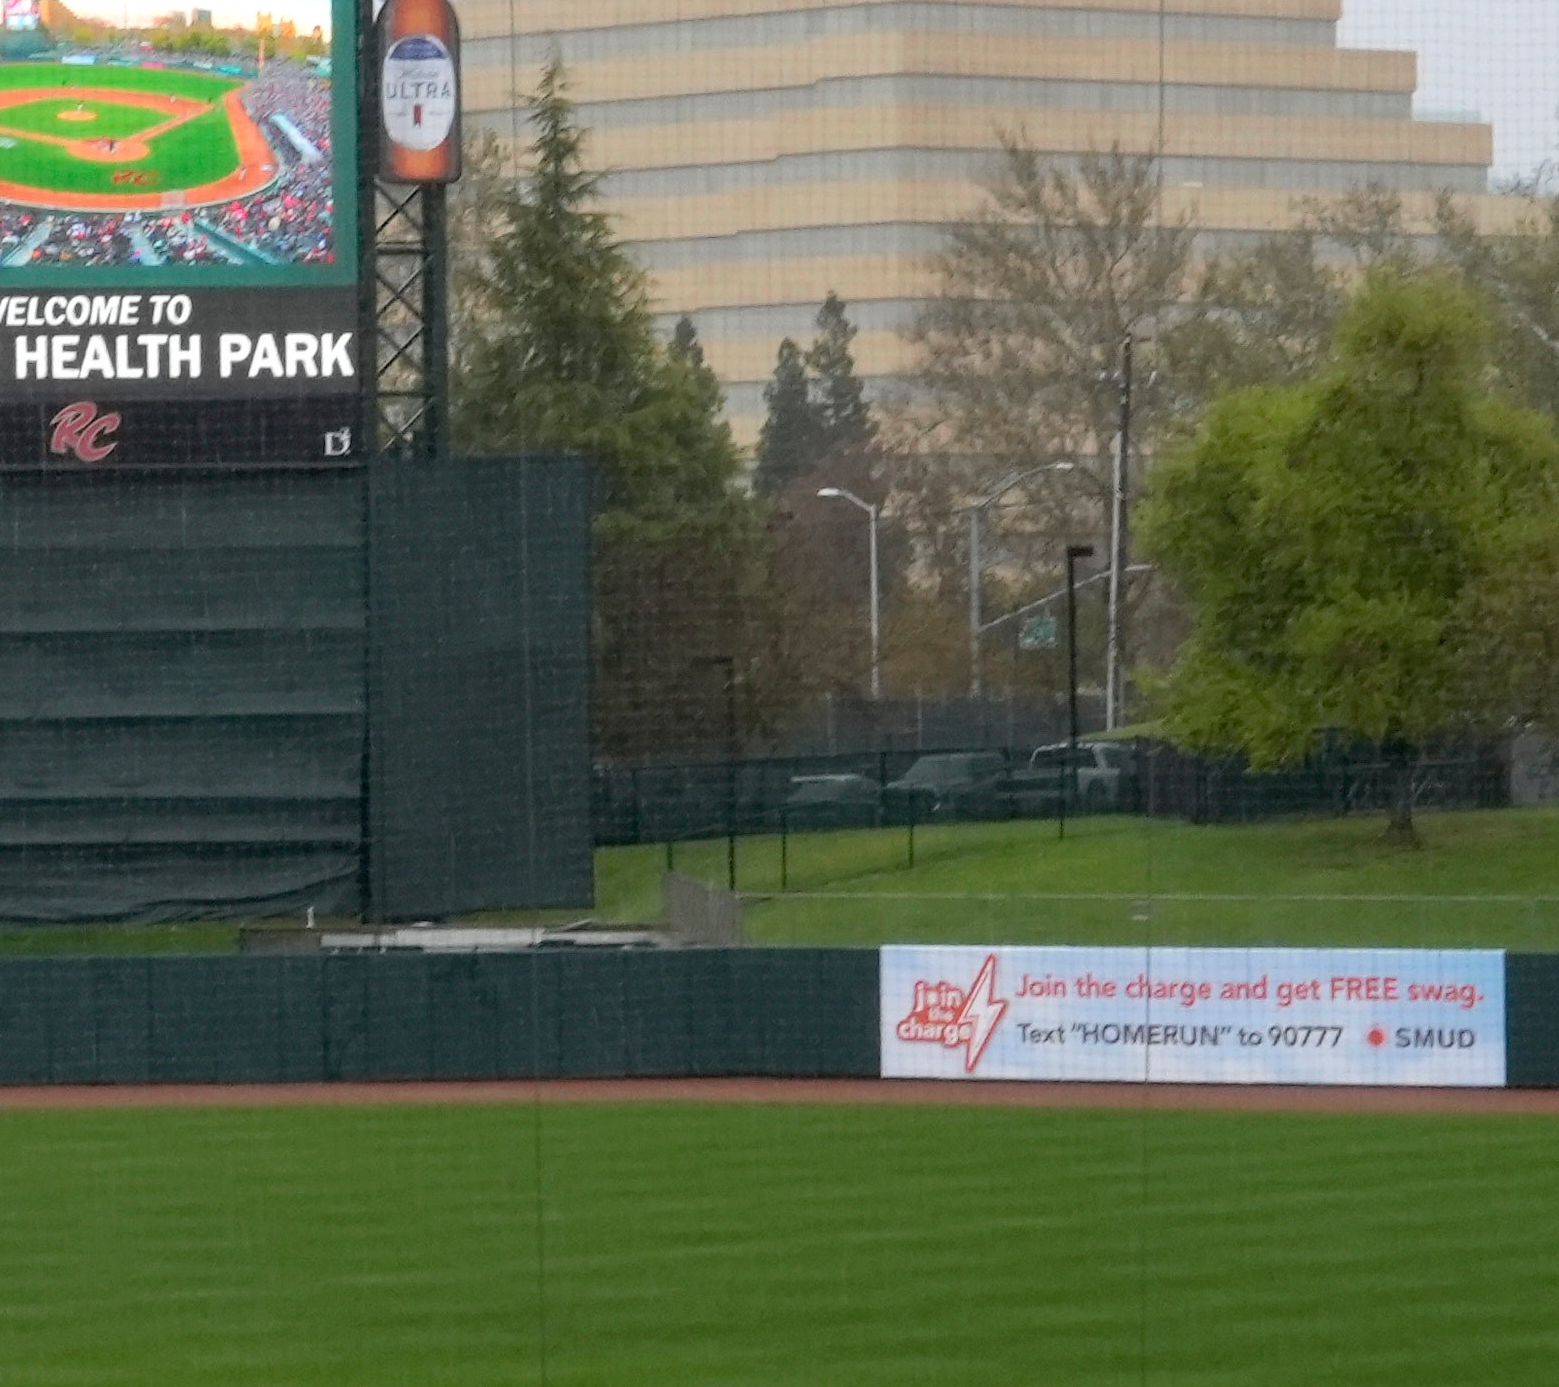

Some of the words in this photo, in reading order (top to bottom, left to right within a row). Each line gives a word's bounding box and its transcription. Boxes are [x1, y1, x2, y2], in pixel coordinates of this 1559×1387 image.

[150, 294, 192, 324] TO
[16, 334, 202, 379] HEALTH
[219, 332, 355, 378] PARK
[914, 981, 963, 1013] join
[1017, 974, 1066, 998] Join
[1074, 973, 1116, 998] the
[1125, 973, 1212, 1007] charge
[1220, 974, 1268, 1001] and
[1276, 979, 1321, 1007] get
[1330, 976, 1399, 1001] FREE
[1408, 982, 1484, 1010] swag.
[898, 1017, 972, 1046] charge
[1017, 1022, 1065, 1044] Text
[1071, 1022, 1231, 1047] "HOMERUN"
[1238, 1026, 1262, 1046] to
[1269, 1025, 1343, 1047] 90777
[1395, 1026, 1475, 1049] SMUD
